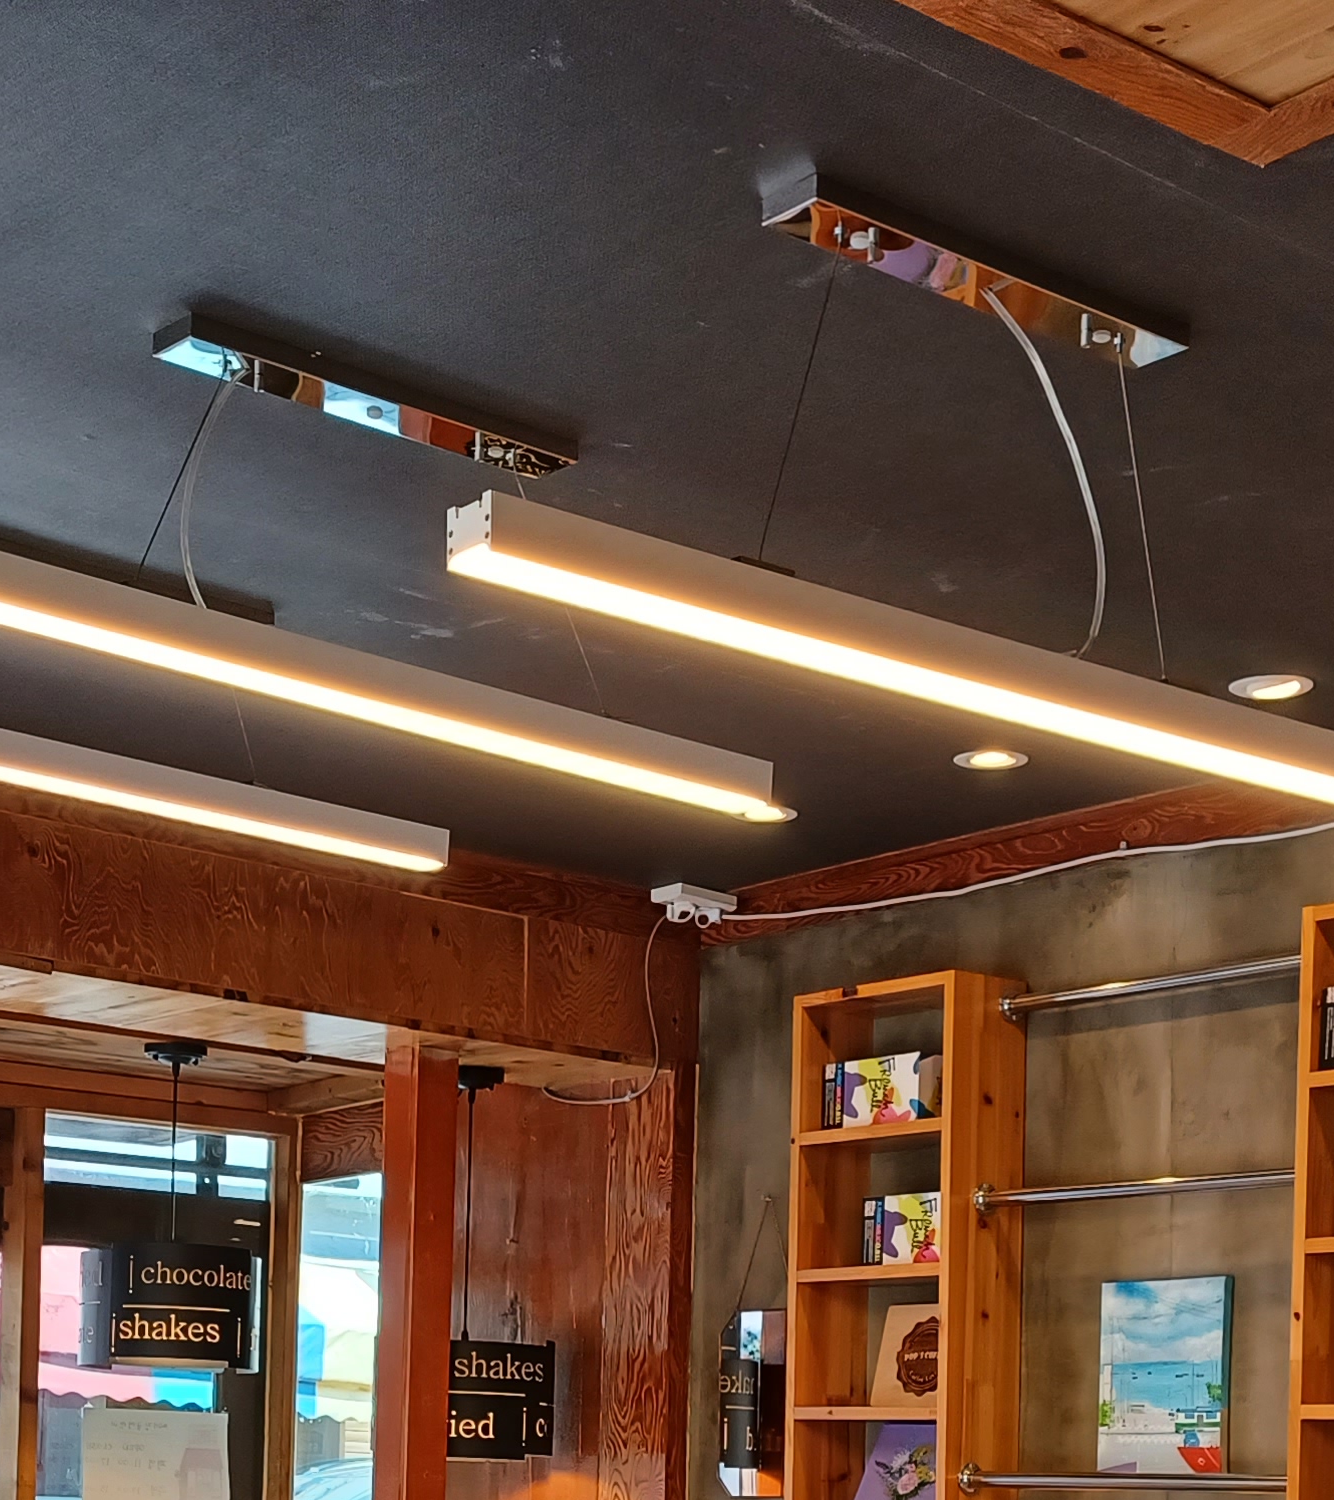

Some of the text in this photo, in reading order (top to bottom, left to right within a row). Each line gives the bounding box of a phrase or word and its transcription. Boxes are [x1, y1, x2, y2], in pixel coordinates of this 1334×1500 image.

[140, 1260, 252, 1291] chocolate
[119, 1312, 220, 1343] shakes
[453, 1351, 544, 1382] shakes
